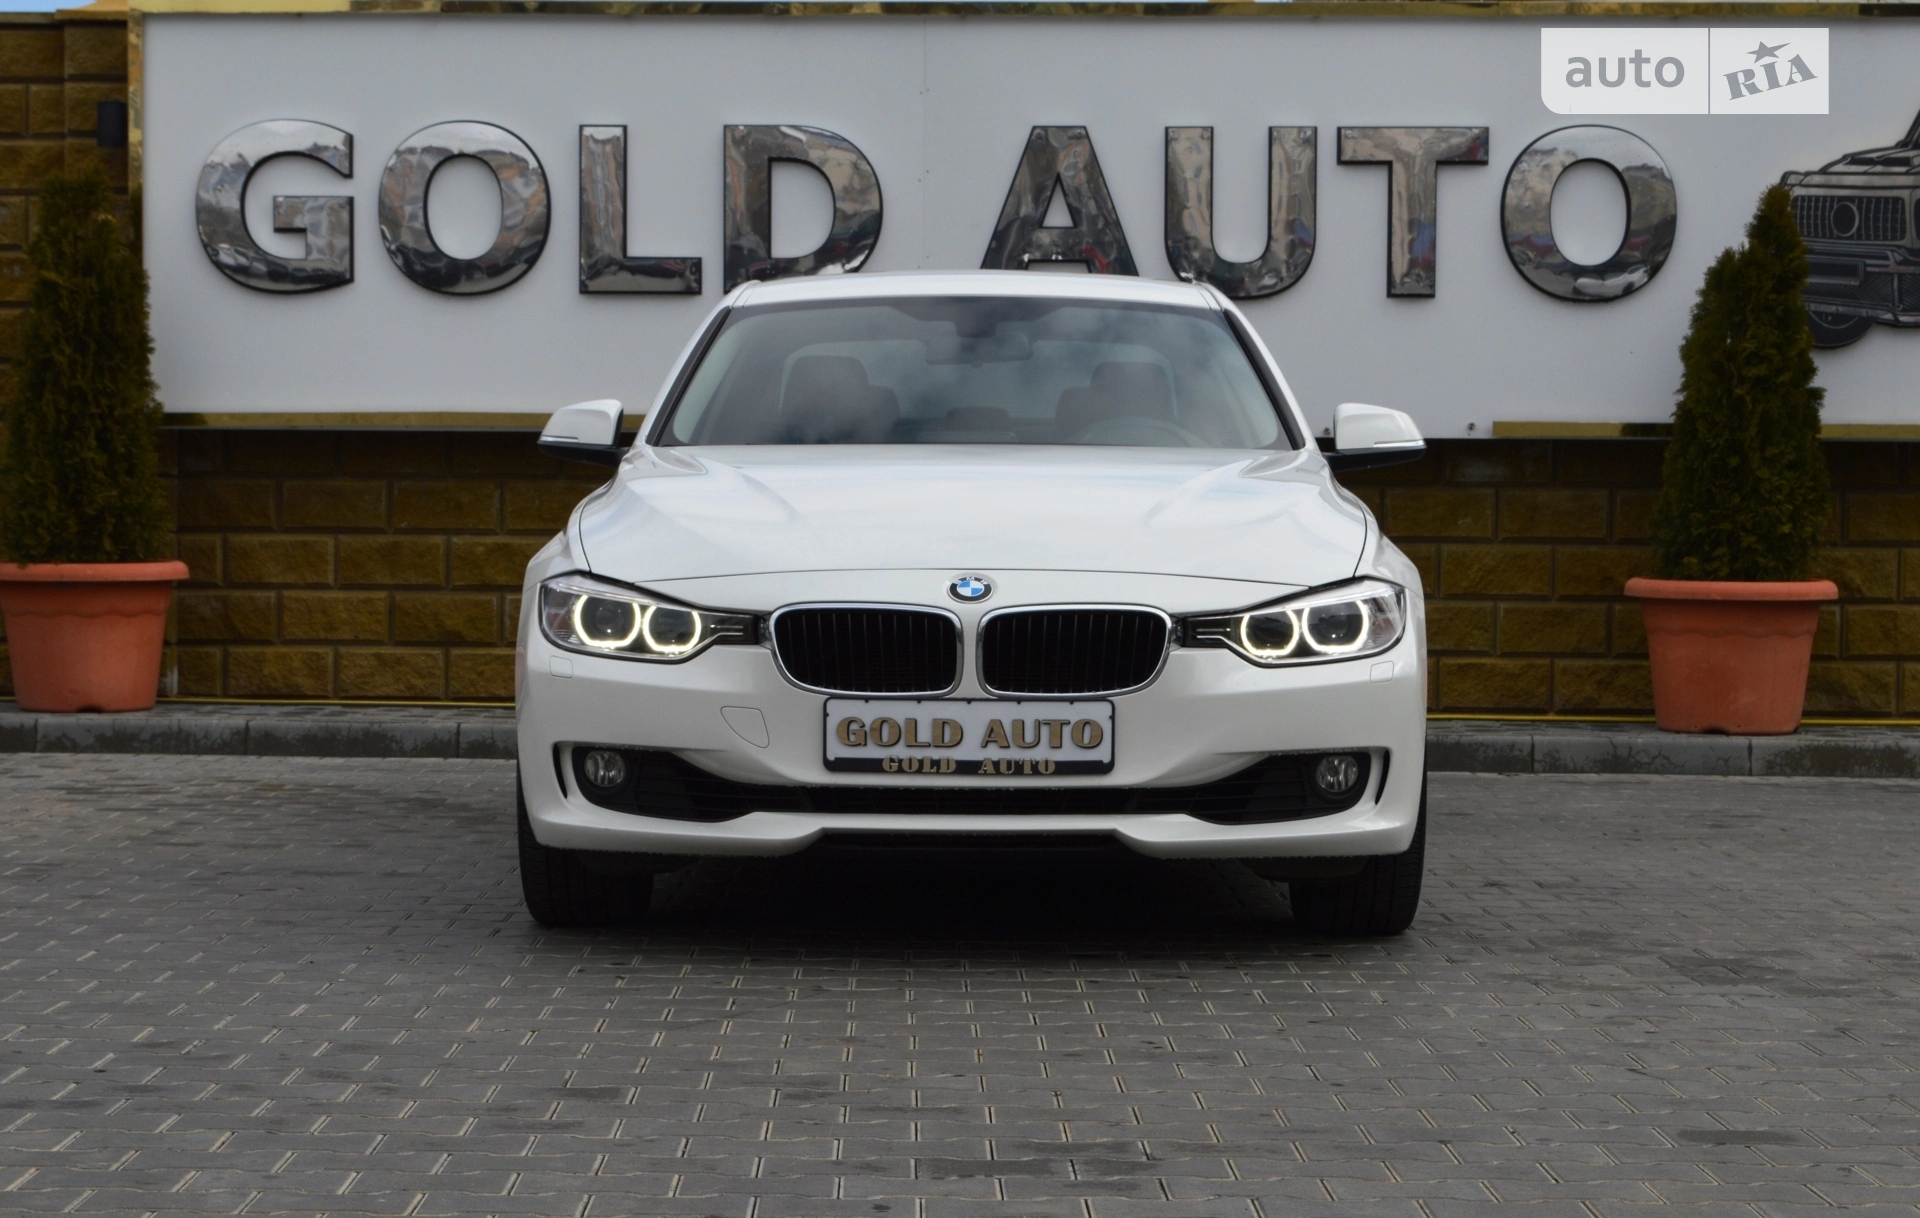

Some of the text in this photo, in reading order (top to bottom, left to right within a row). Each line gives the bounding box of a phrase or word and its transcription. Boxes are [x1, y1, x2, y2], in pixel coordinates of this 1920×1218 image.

[196, 118, 1679, 303] GOLD AUTO
[836, 716, 1104, 749] GOLD AUTO
[882, 755, 1056, 775] GOLD AUTO
